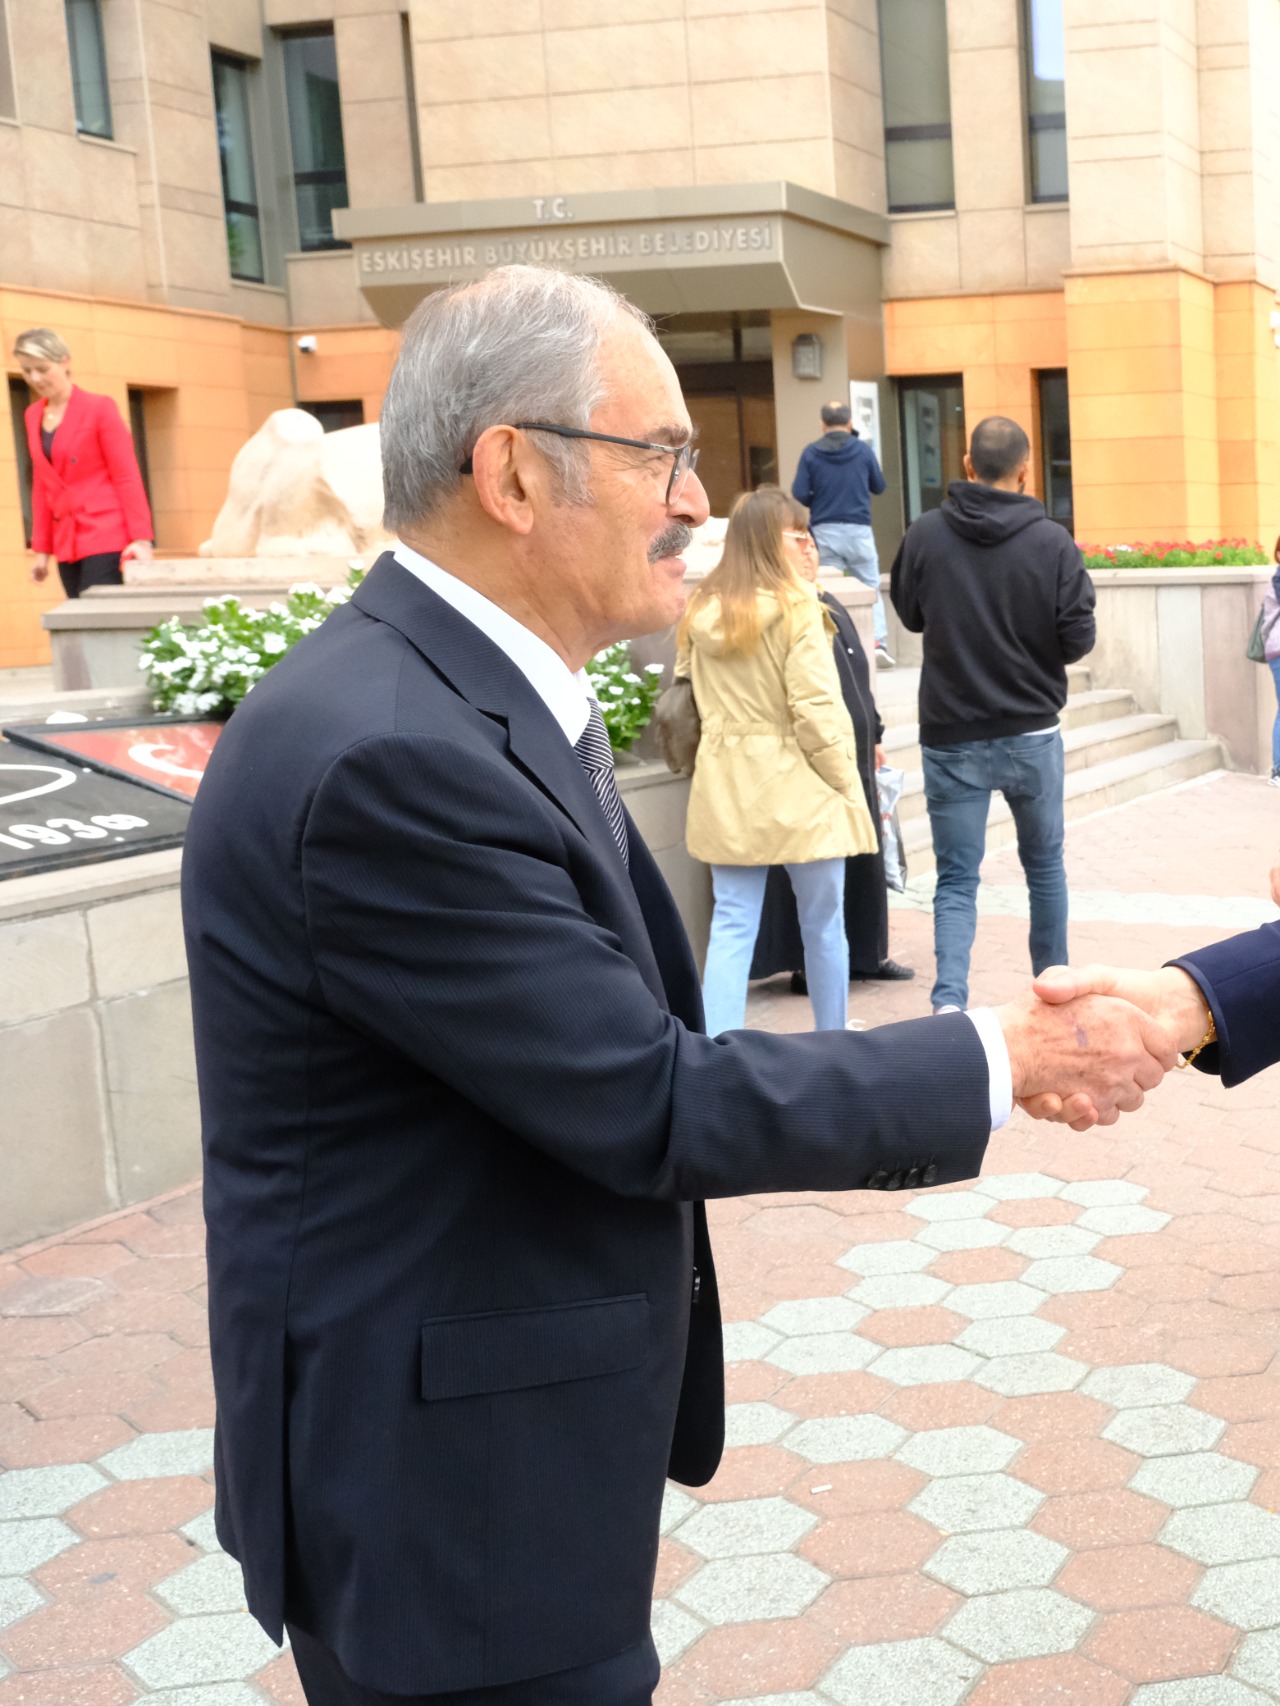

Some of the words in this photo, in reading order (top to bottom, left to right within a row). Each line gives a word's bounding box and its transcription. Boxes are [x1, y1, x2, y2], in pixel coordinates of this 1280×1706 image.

[533, 198, 575, 220] T.C.
[361, 242, 477, 275] ESKİŞEHİR
[484, 230, 633, 268] BÜYÜKŞEHİR
[640, 221, 772, 256] BELEDİYESİ
